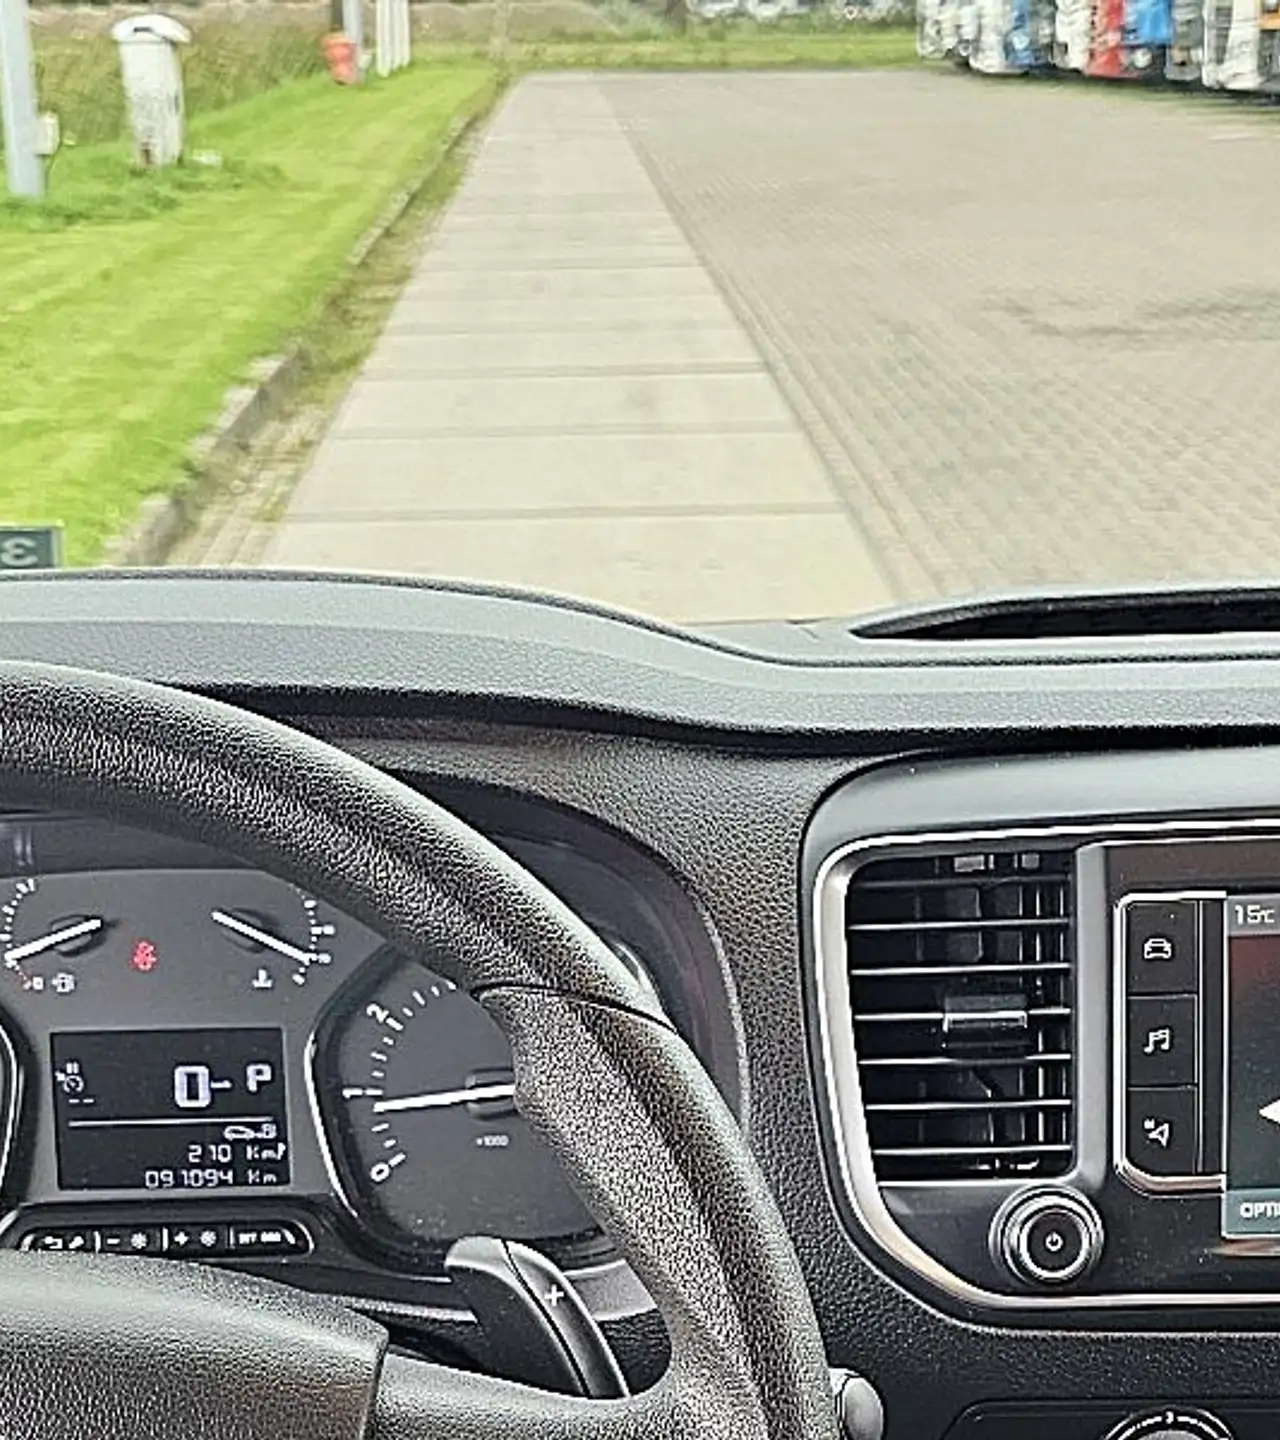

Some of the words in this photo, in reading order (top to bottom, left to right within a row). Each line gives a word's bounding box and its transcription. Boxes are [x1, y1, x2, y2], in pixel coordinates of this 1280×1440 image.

[366, 1003, 390, 1023] 2
[245, 1063, 273, 1093] P
[188, 1144, 232, 1163] 210
[145, 1168, 234, 1188] 091094
[370, 1162, 391, 1184] 0
